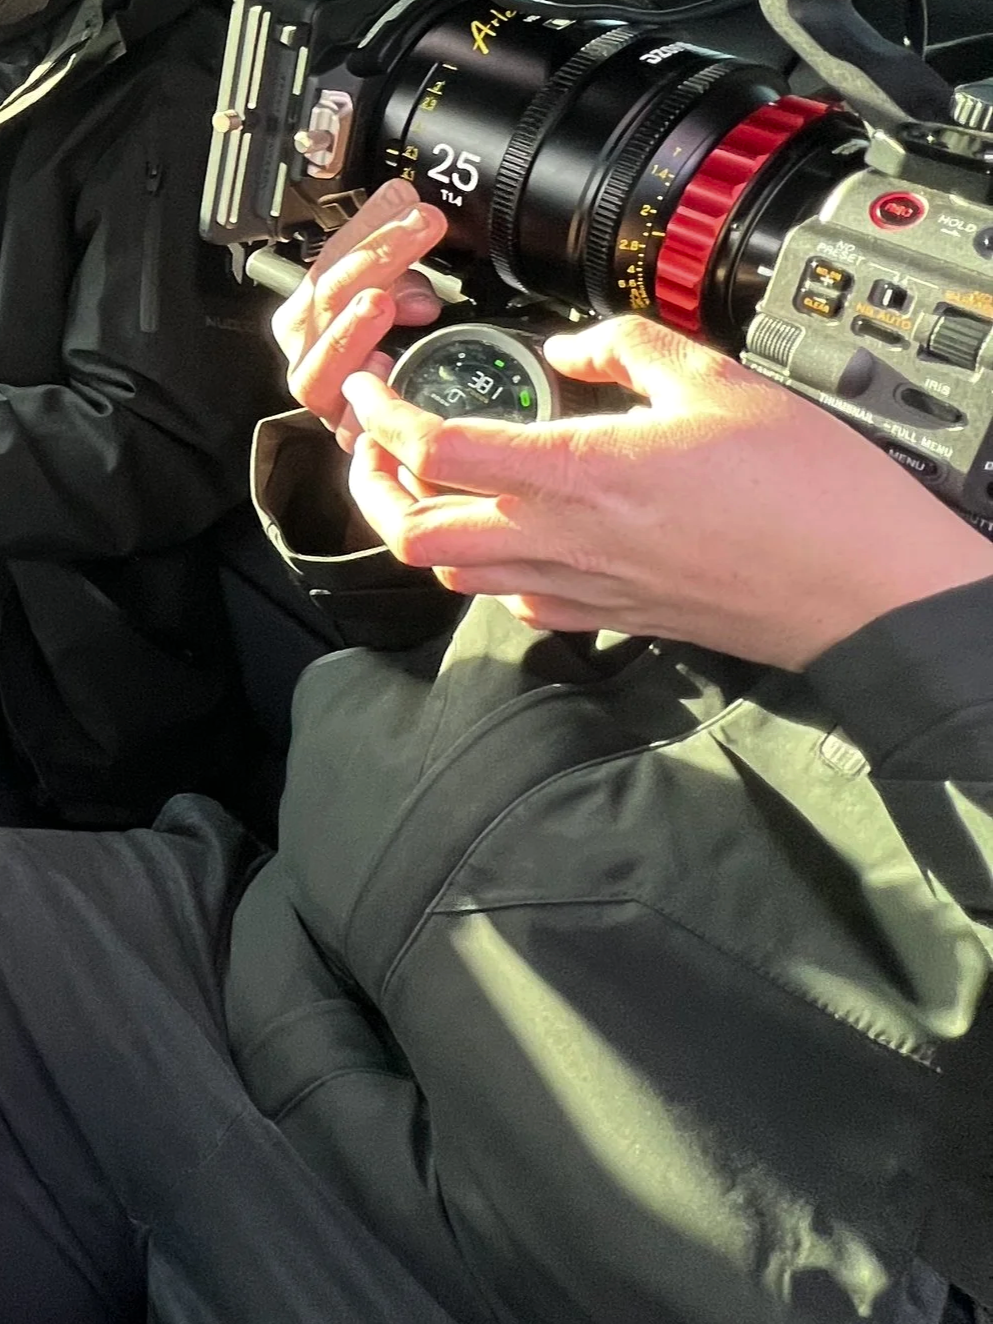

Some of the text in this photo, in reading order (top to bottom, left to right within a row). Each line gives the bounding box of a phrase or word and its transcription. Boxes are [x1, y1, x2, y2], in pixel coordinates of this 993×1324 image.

[470, 9, 517, 54] Arle
[427, 143, 481, 192] 25
[640, 204, 651, 216] 2
[938, 215, 977, 232] HOLD
[816, 242, 866, 266] PRESET
[878, 311, 912, 330] AUTO
[925, 378, 951, 397] IRIS
[819, 392, 875, 425] THUMBNAIL
[890, 424, 954, 458] FULL MENU
[888, 448, 925, 471] MENU
